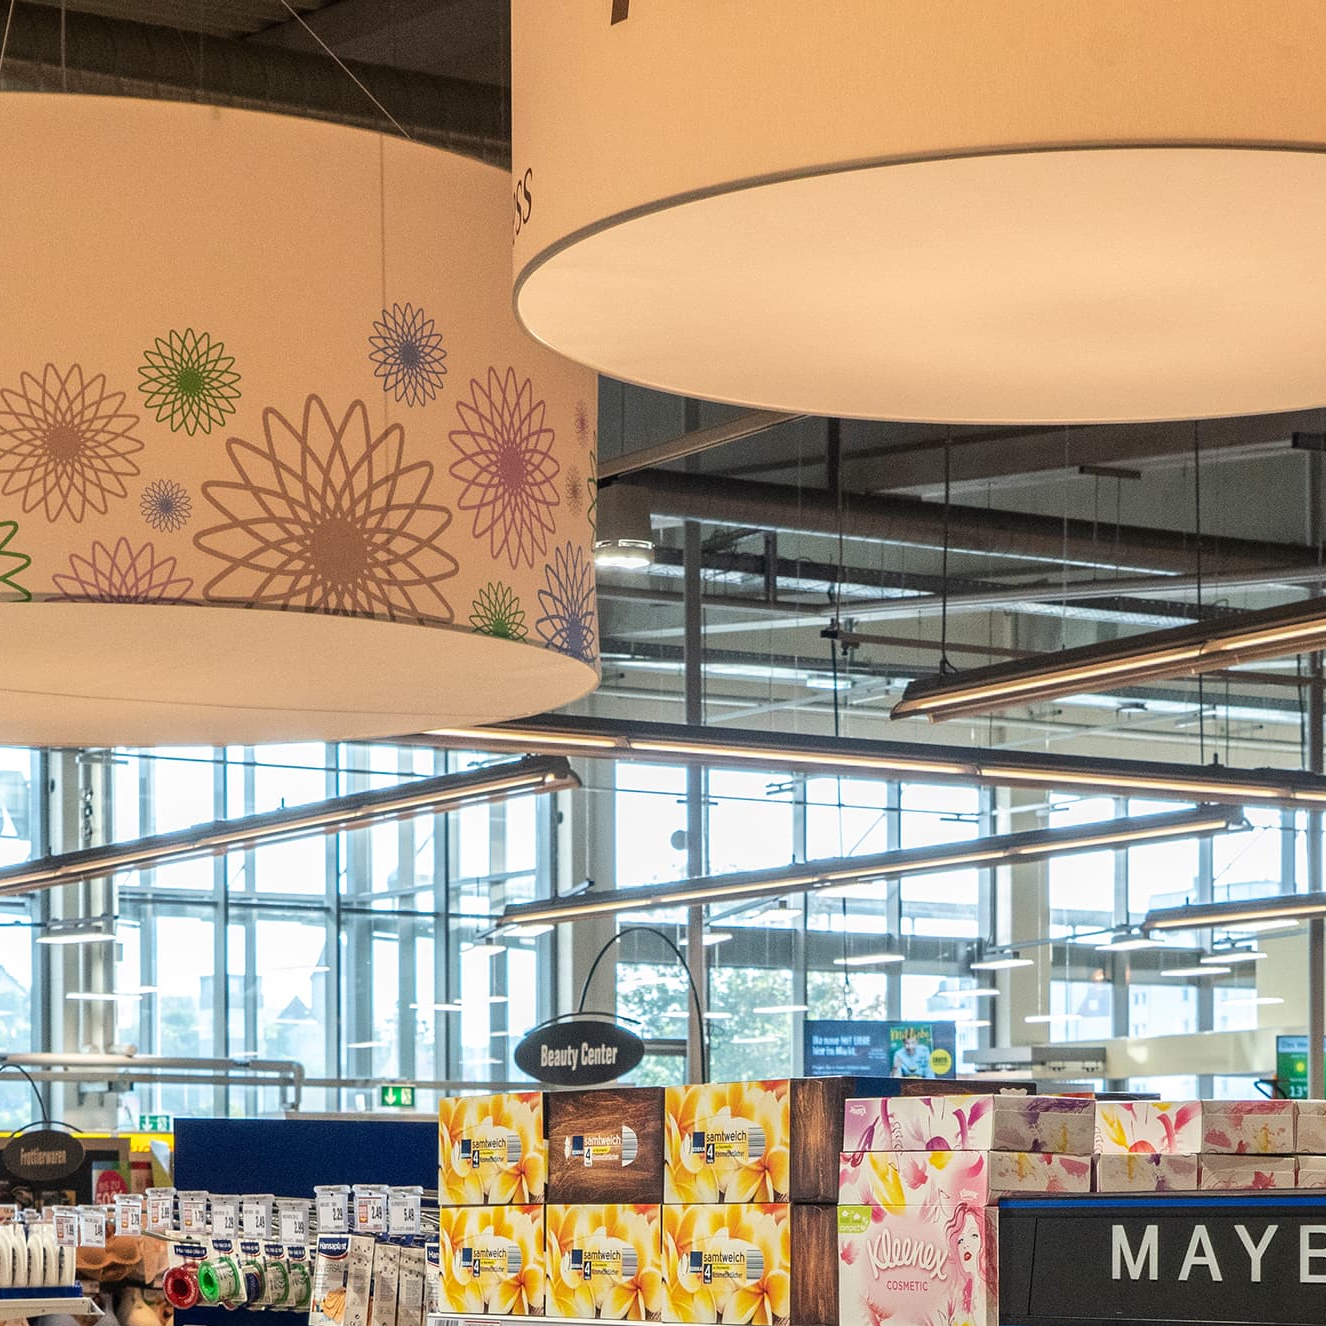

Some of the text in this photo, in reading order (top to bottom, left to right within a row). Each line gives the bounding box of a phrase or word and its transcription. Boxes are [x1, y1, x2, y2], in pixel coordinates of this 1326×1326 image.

[540, 1043, 618, 1070] Beauty Center
[472, 1138, 506, 1150] samtweich
[584, 1136, 621, 1146] samtweich
[706, 1132, 747, 1144] samtweich
[333, 1206, 343, 1221] 2.29
[371, 1206, 383, 1221] 2.49
[404, 1206, 415, 1222] 5.49
[318, 1239, 348, 1251] Hansaplast
[473, 1248, 507, 1259] samtweich
[703, 1252, 745, 1264] samtweich
[868, 1230, 948, 1280] Kleenex
[886, 1280, 928, 1292] COSMETIC
